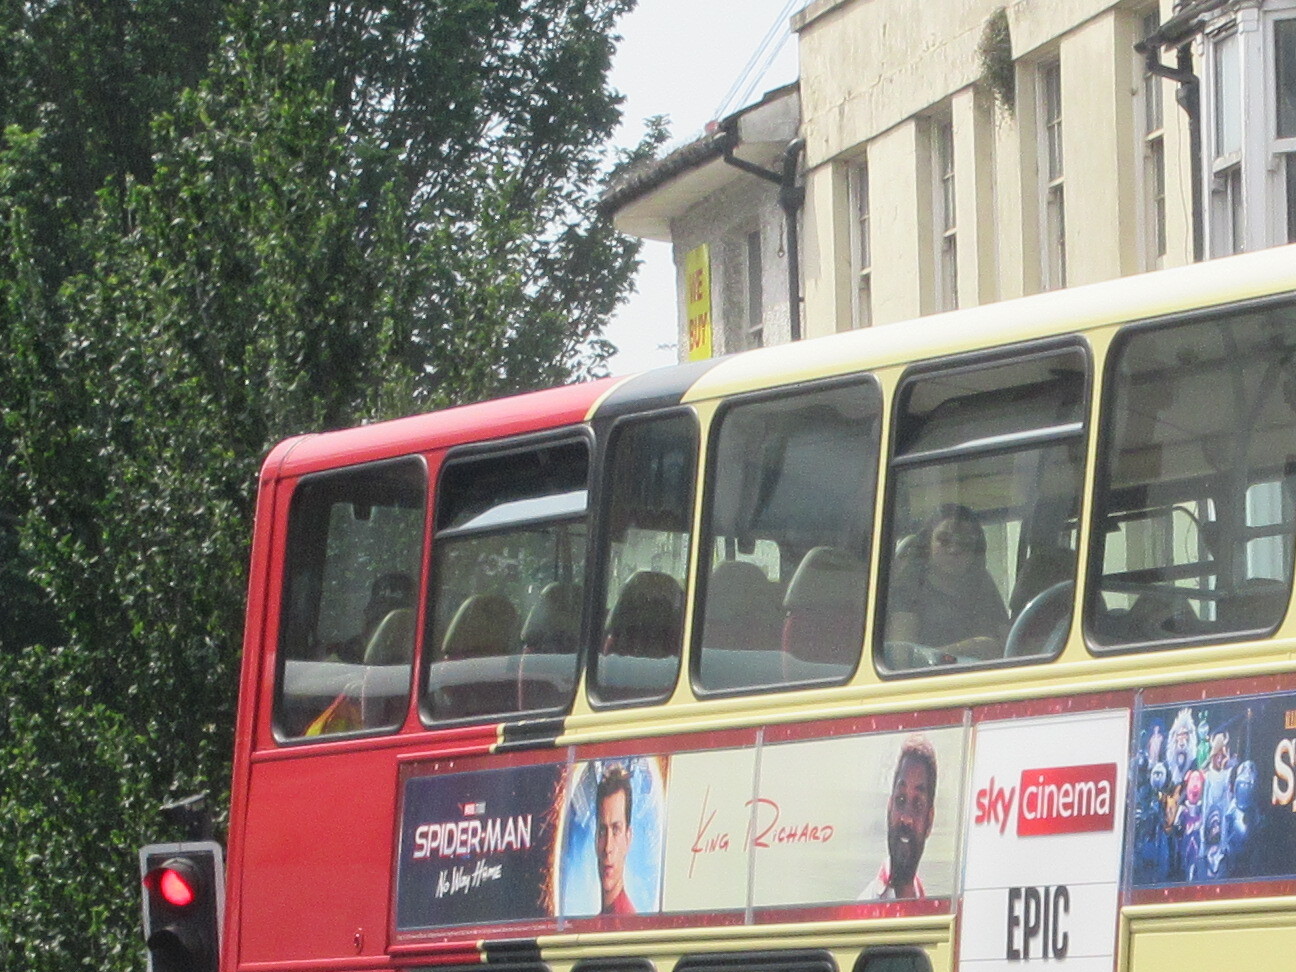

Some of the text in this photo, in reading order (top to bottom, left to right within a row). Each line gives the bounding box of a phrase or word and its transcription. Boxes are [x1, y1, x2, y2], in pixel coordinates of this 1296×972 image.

[689, 311, 708, 353] BUY
[975, 774, 1112, 836] sky cinema
[413, 813, 533, 860] SPIDER-MAN
[1005, 884, 1070, 962] EPIC
